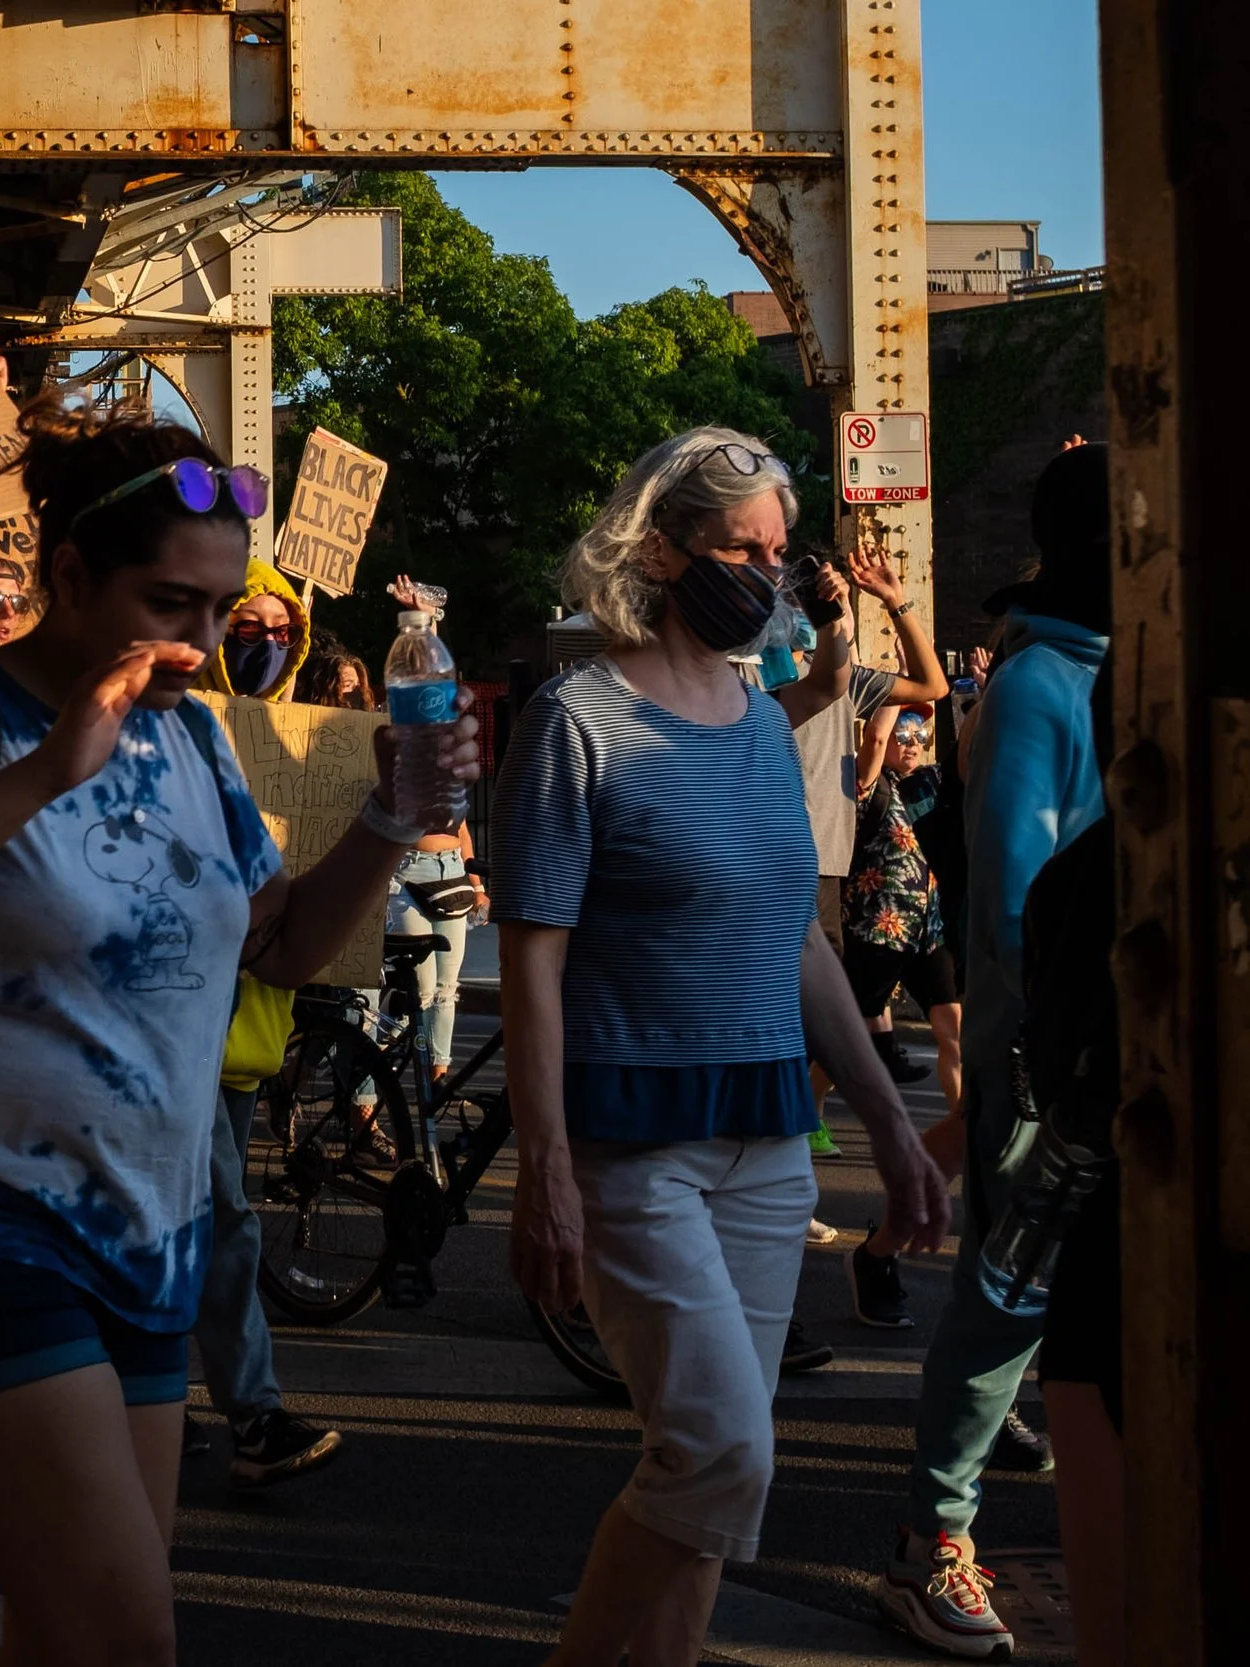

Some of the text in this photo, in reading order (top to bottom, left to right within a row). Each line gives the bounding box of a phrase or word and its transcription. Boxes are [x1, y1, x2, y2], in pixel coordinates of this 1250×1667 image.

[301, 442, 377, 503] BLACK
[850, 488, 921, 500] TOW ZONE
[294, 486, 366, 545] LIVES
[281, 526, 355, 589] MATTER
[248, 708, 361, 763] Lives
